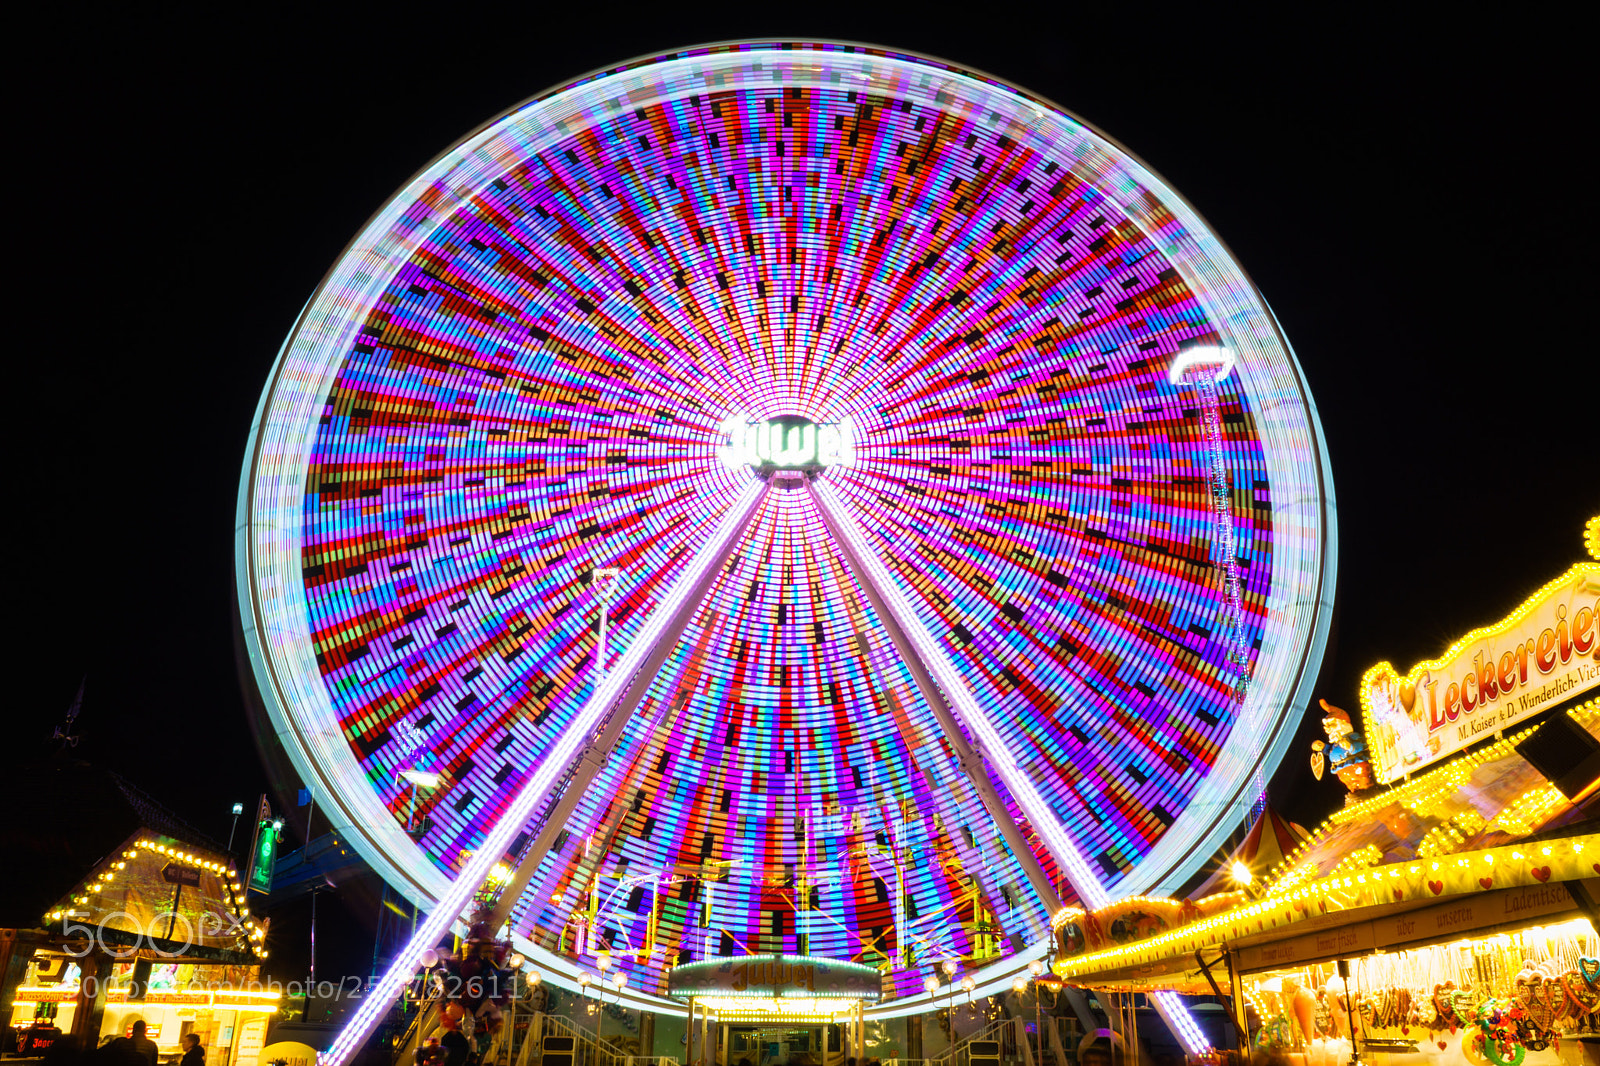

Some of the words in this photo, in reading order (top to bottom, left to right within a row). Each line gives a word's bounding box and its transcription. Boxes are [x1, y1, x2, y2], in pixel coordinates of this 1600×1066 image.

[716, 412, 857, 470] Juwel
[1458, 726, 1469, 742] M.
[1471, 715, 1496, 735] Kaiser
[1500, 711, 1505, 721] &
[1507, 702, 1517, 718] D.
[1317, 936, 1336, 952] Immer
[1337, 926, 1358, 953] frisch
[1397, 914, 1416, 937] über
[1436, 907, 1473, 929] unseren
[731, 962, 816, 992] Juwel
